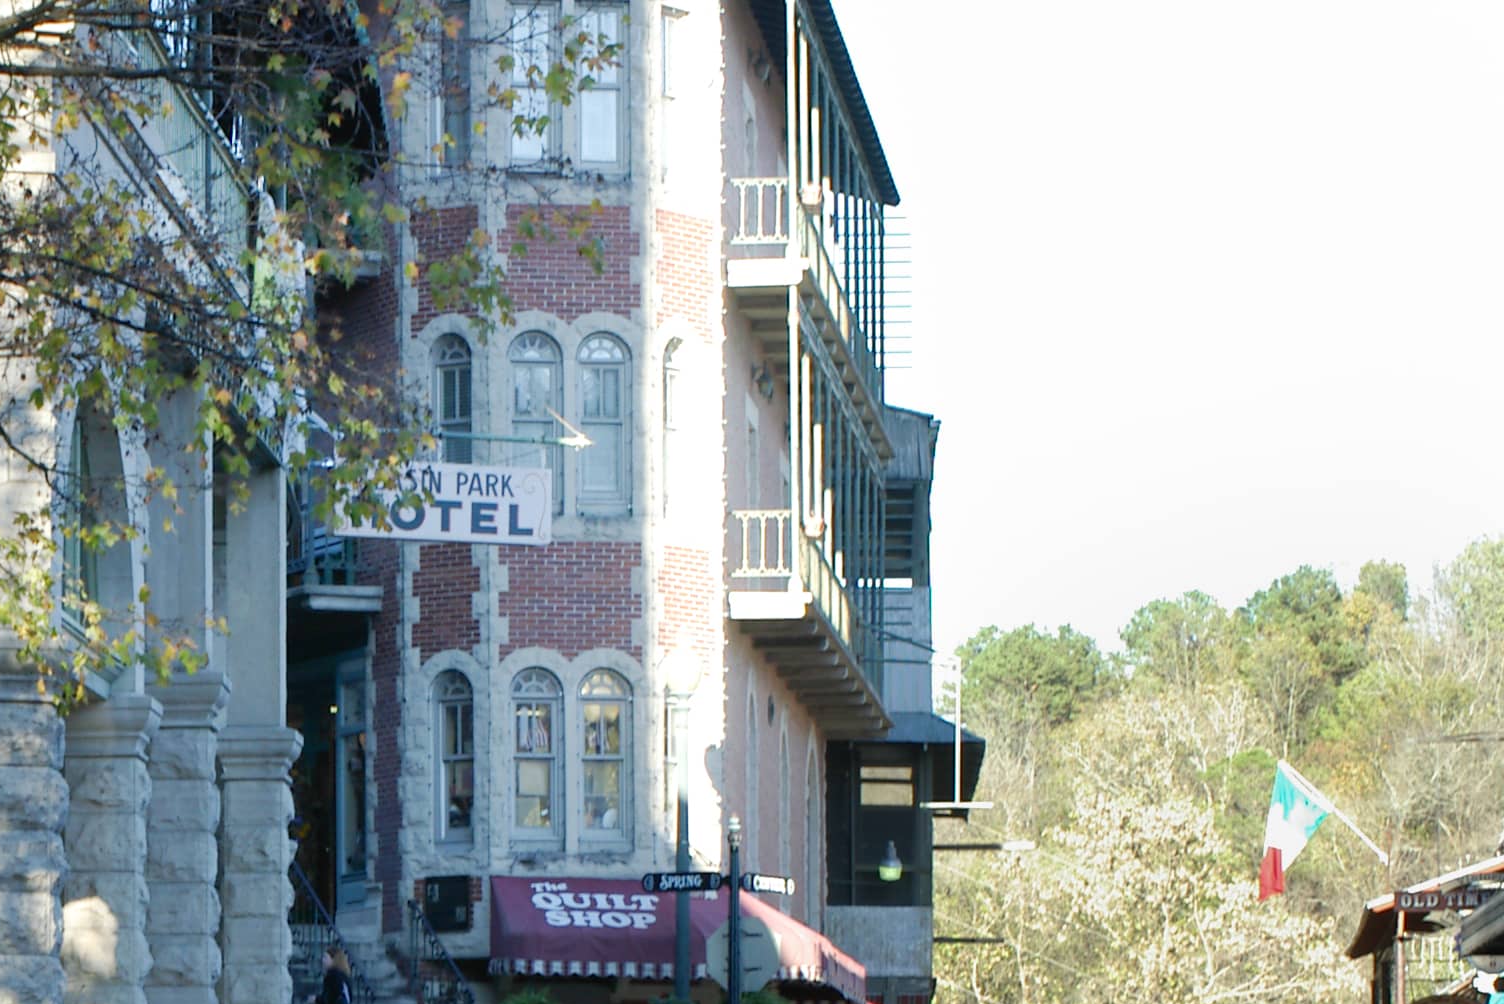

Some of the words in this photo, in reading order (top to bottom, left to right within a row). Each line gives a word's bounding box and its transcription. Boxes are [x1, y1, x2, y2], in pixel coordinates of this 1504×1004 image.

[456, 472, 514, 497] PARK
[530, 881, 568, 893] The
[659, 874, 703, 890] SPRING
[531, 892, 660, 911] QUILT
[1400, 894, 1439, 908] OLD
[544, 910, 657, 930] SHOP
